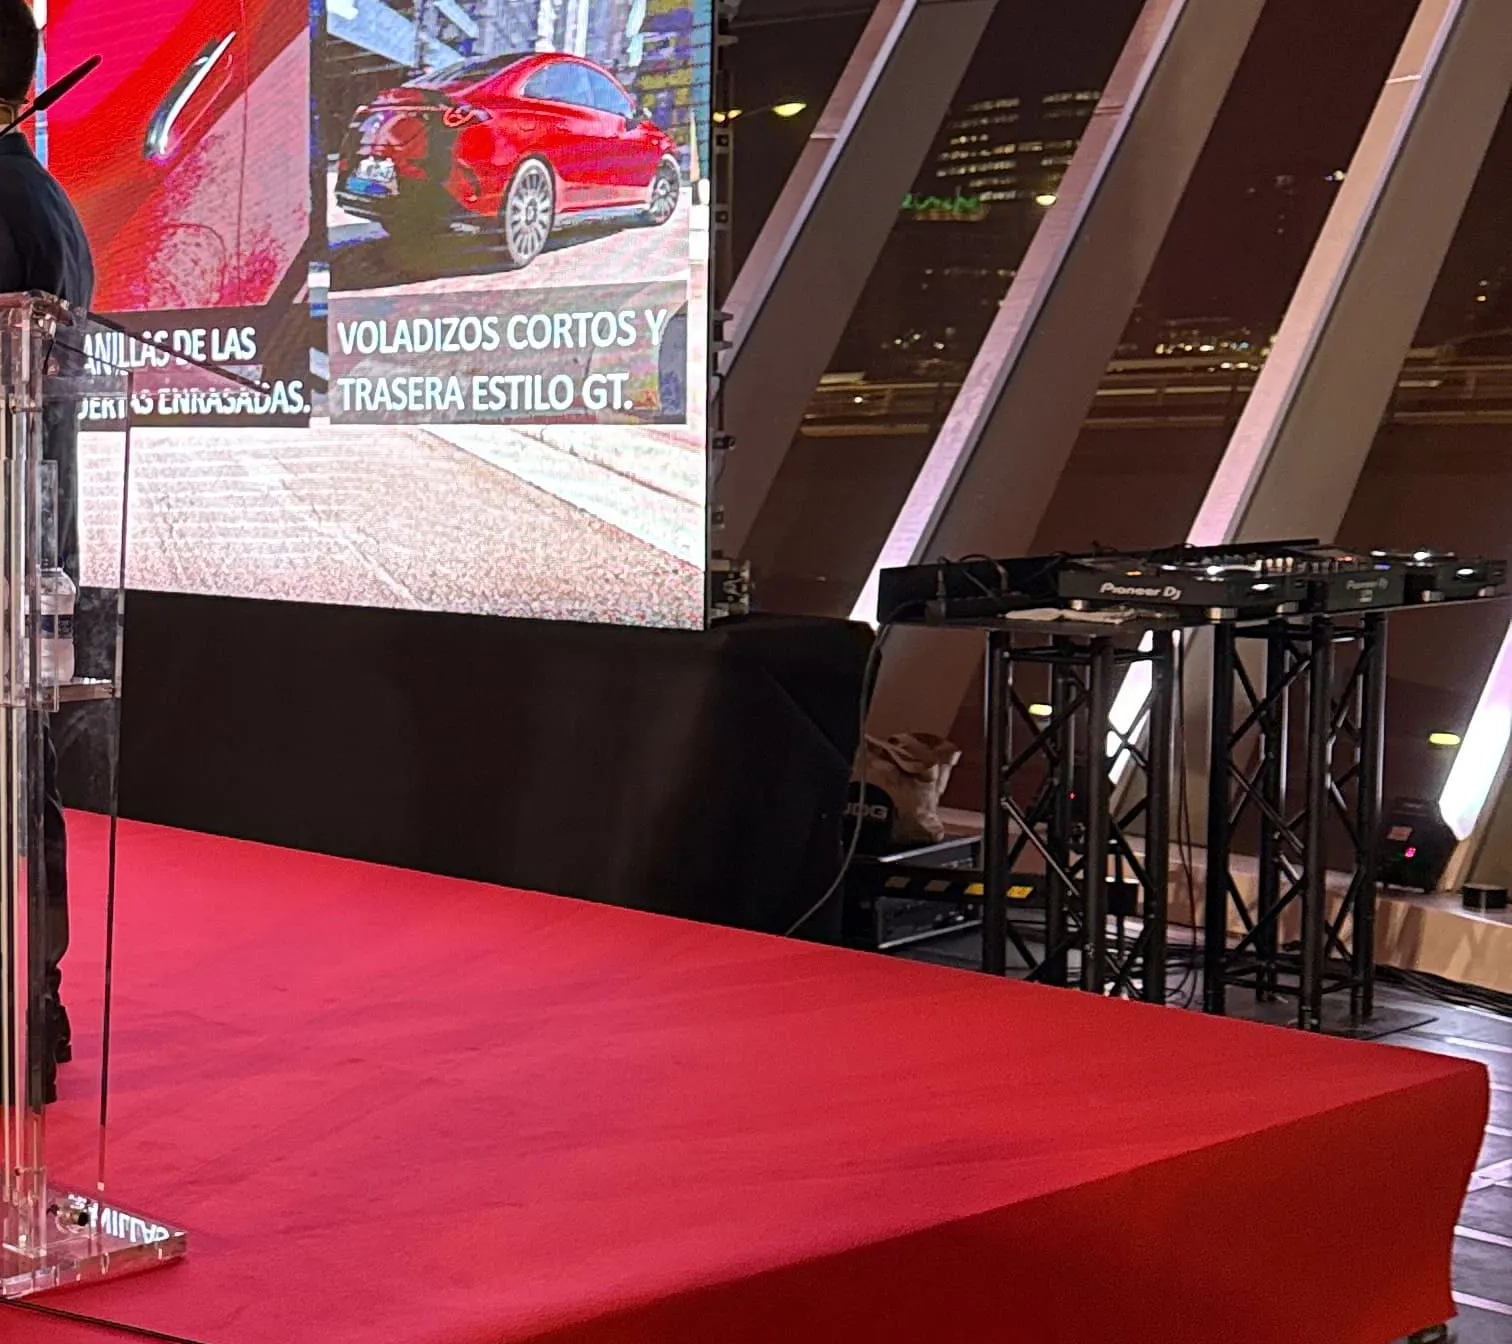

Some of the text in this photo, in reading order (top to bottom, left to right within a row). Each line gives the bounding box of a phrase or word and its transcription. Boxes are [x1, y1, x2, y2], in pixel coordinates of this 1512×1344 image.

[83, 327, 257, 375] ANILLAS DE LAS
[336, 308, 668, 355] VOLADIZOS CORTOS Y
[337, 372, 633, 411] TRASERA ESTILO GT.
[1099, 582, 1161, 596] Pioneer
